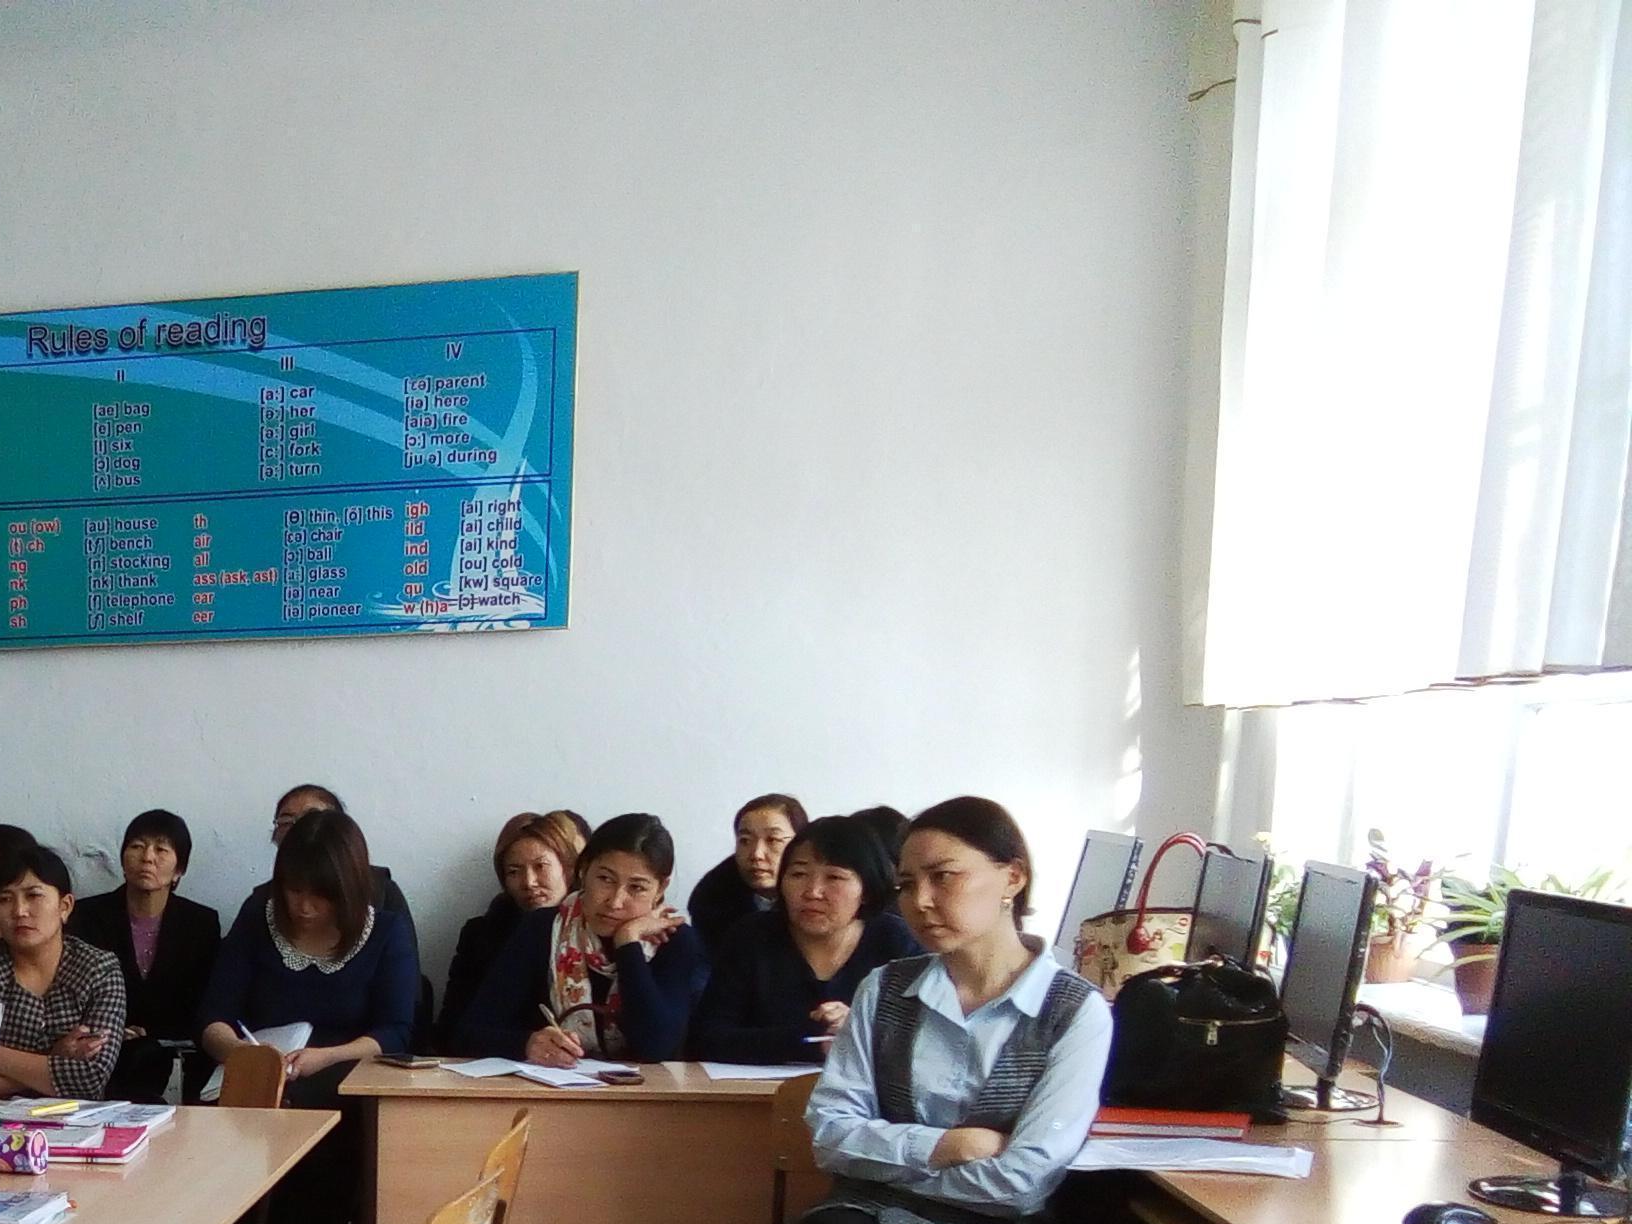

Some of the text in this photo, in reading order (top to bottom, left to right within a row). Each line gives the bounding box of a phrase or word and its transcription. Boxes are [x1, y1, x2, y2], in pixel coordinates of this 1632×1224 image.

[27, 313, 267, 355] Rules of reading
[281, 357, 294, 370] III
[446, 343, 462, 359] IV
[436, 375, 486, 391] parent
[290, 387, 315, 399] car
[434, 396, 468, 407] here
[124, 403, 150, 416] bag
[290, 405, 315, 417] her
[443, 413, 468, 425] fire
[116, 422, 141, 433] pen
[290, 423, 315, 440] girl
[112, 439, 133, 451] six
[431, 433, 469, 445] more
[290, 442, 320, 456] fork
[447, 450, 497, 463] during
[114, 458, 140, 470] dog
[289, 463, 320, 476] turn
[115, 475, 140, 486] bus
[367, 507, 393, 520] this
[406, 502, 429, 518] igh
[488, 500, 521, 515] right
[115, 518, 158, 531] house
[487, 518, 522, 532] child
[194, 535, 211, 547] air
[311, 529, 343, 542] chair
[110, 536, 152, 550] bench
[487, 537, 517, 550] kind
[307, 547, 331, 561] ball
[111, 555, 170, 569] stocking
[405, 561, 428, 574] old
[492, 555, 522, 569] cold
[193, 573, 215, 585] ass
[309, 565, 346, 581] glass
[118, 574, 157, 588] thank
[493, 575, 542, 589] square
[193, 593, 214, 604] ear
[309, 586, 340, 598] near
[107, 594, 174, 610] telephone
[479, 594, 521, 606] watch
[308, 603, 361, 619] pioneer
[109, 612, 143, 625] shelf
